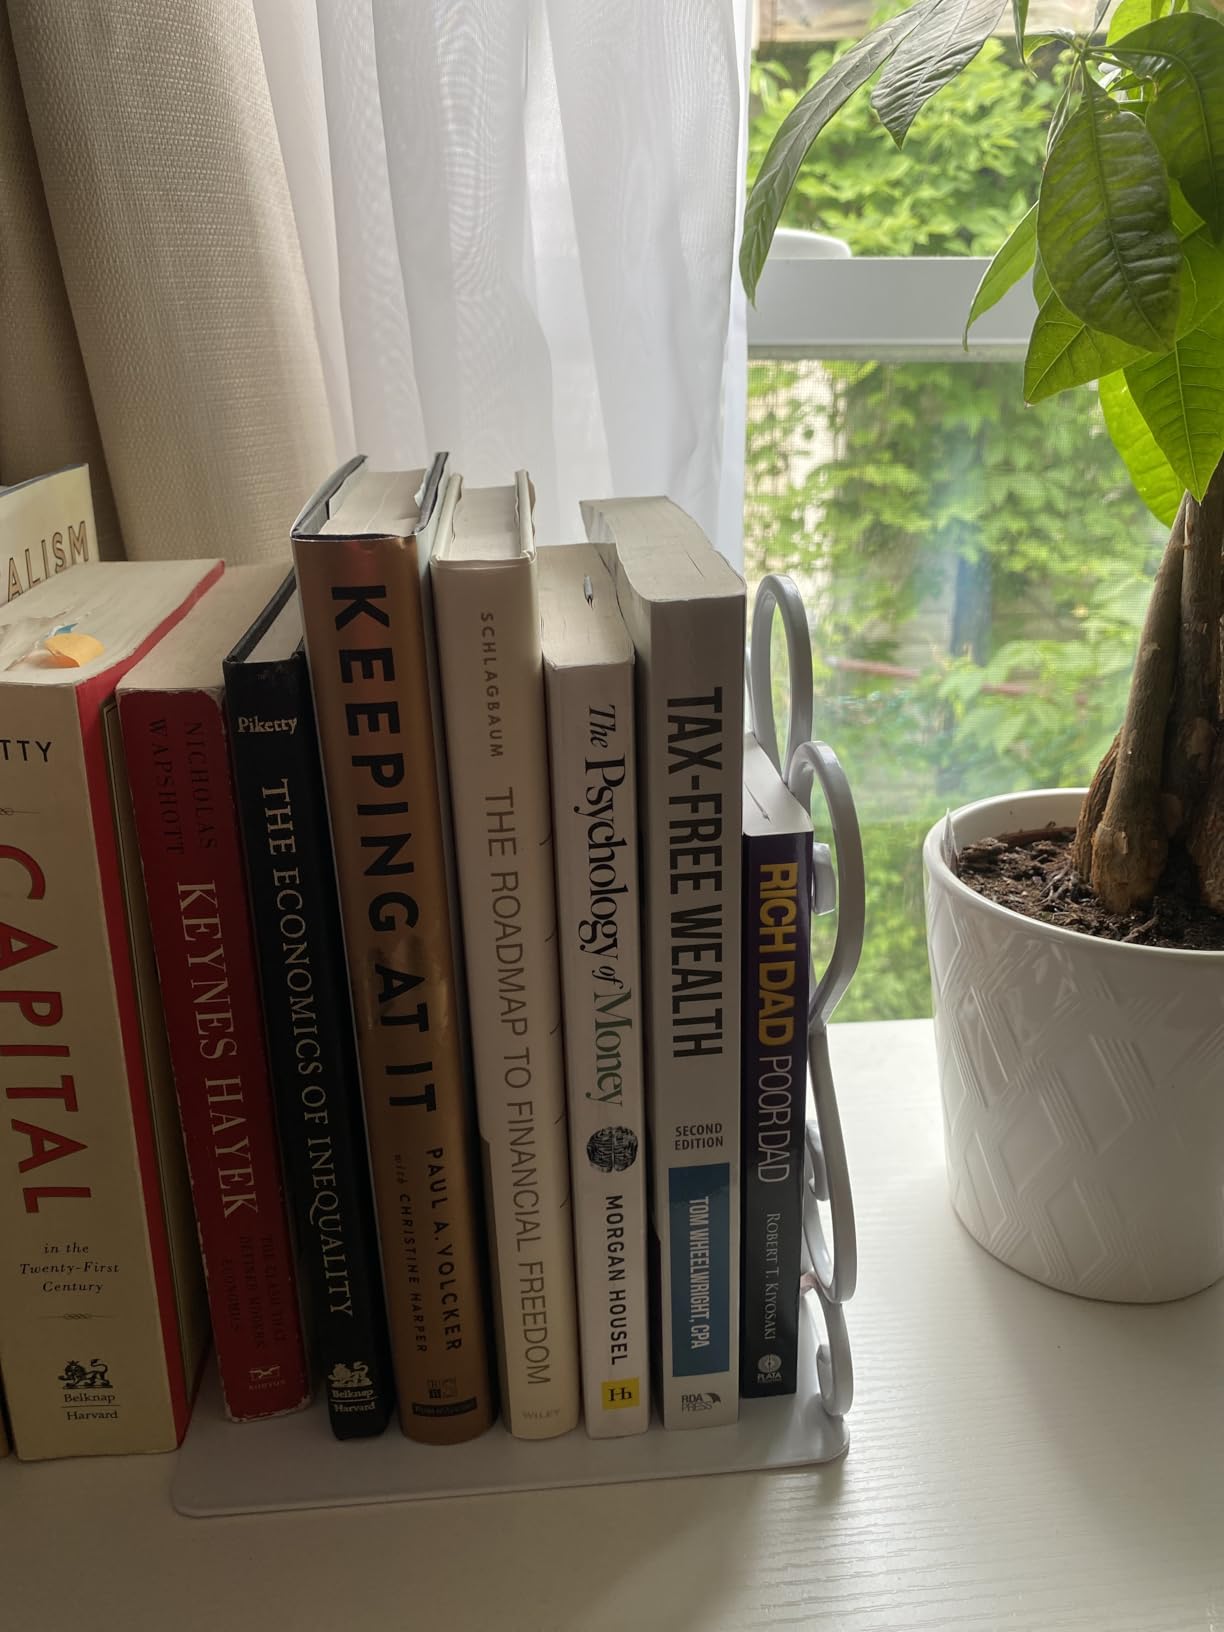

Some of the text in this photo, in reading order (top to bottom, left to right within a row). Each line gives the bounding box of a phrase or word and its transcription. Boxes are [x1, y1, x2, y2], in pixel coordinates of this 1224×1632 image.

[237, 715, 298, 736] Piketty
[481, 612, 503, 758] SCHLAGBAUM
[184, 721, 218, 850] NICHOLAS
[331, 585, 437, 1112] KEEPING AT IT
[667, 686, 723, 1058] TAX-FREE WEALTH
[574, 704, 633, 1107] The Psychology of Money
[177, 879, 239, 1060] KEYNES
[262, 778, 354, 1317] THE ECONOMICS OF INEQUALITY
[757, 862, 798, 1184] RICH DAD POOR DAD
[485, 786, 551, 1385] THE ROADMAP TO FINANCIAL FREEDOM
[675, 1122, 722, 1137] SECOND
[204, 1075, 259, 1218] HAYEK
[675, 1136, 723, 1151] EDITION
[19, 1261, 120, 1275] Twenty-First
[43, 1241, 89, 1254] in the
[399, 1193, 420, 1284] CHRISTINE
[426, 1147, 462, 1351] PAUL A. VOLCKER
[605, 1195, 627, 1366] MORGAN HOUSEL
[689, 1196, 710, 1350] TOM WHEELWRIGHT, CPA
[765, 1266, 780, 1279] T.
[42, 1281, 104, 1294] Century
[409, 1293, 427, 1353] HARPER
[64, 1392, 116, 1404] Belknap
[66, 1409, 118, 1421] Harvard
[334, 1401, 376, 1413] Harvard
[681, 1393, 703, 1403] RDA
[681, 1401, 712, 1412] PRESS
